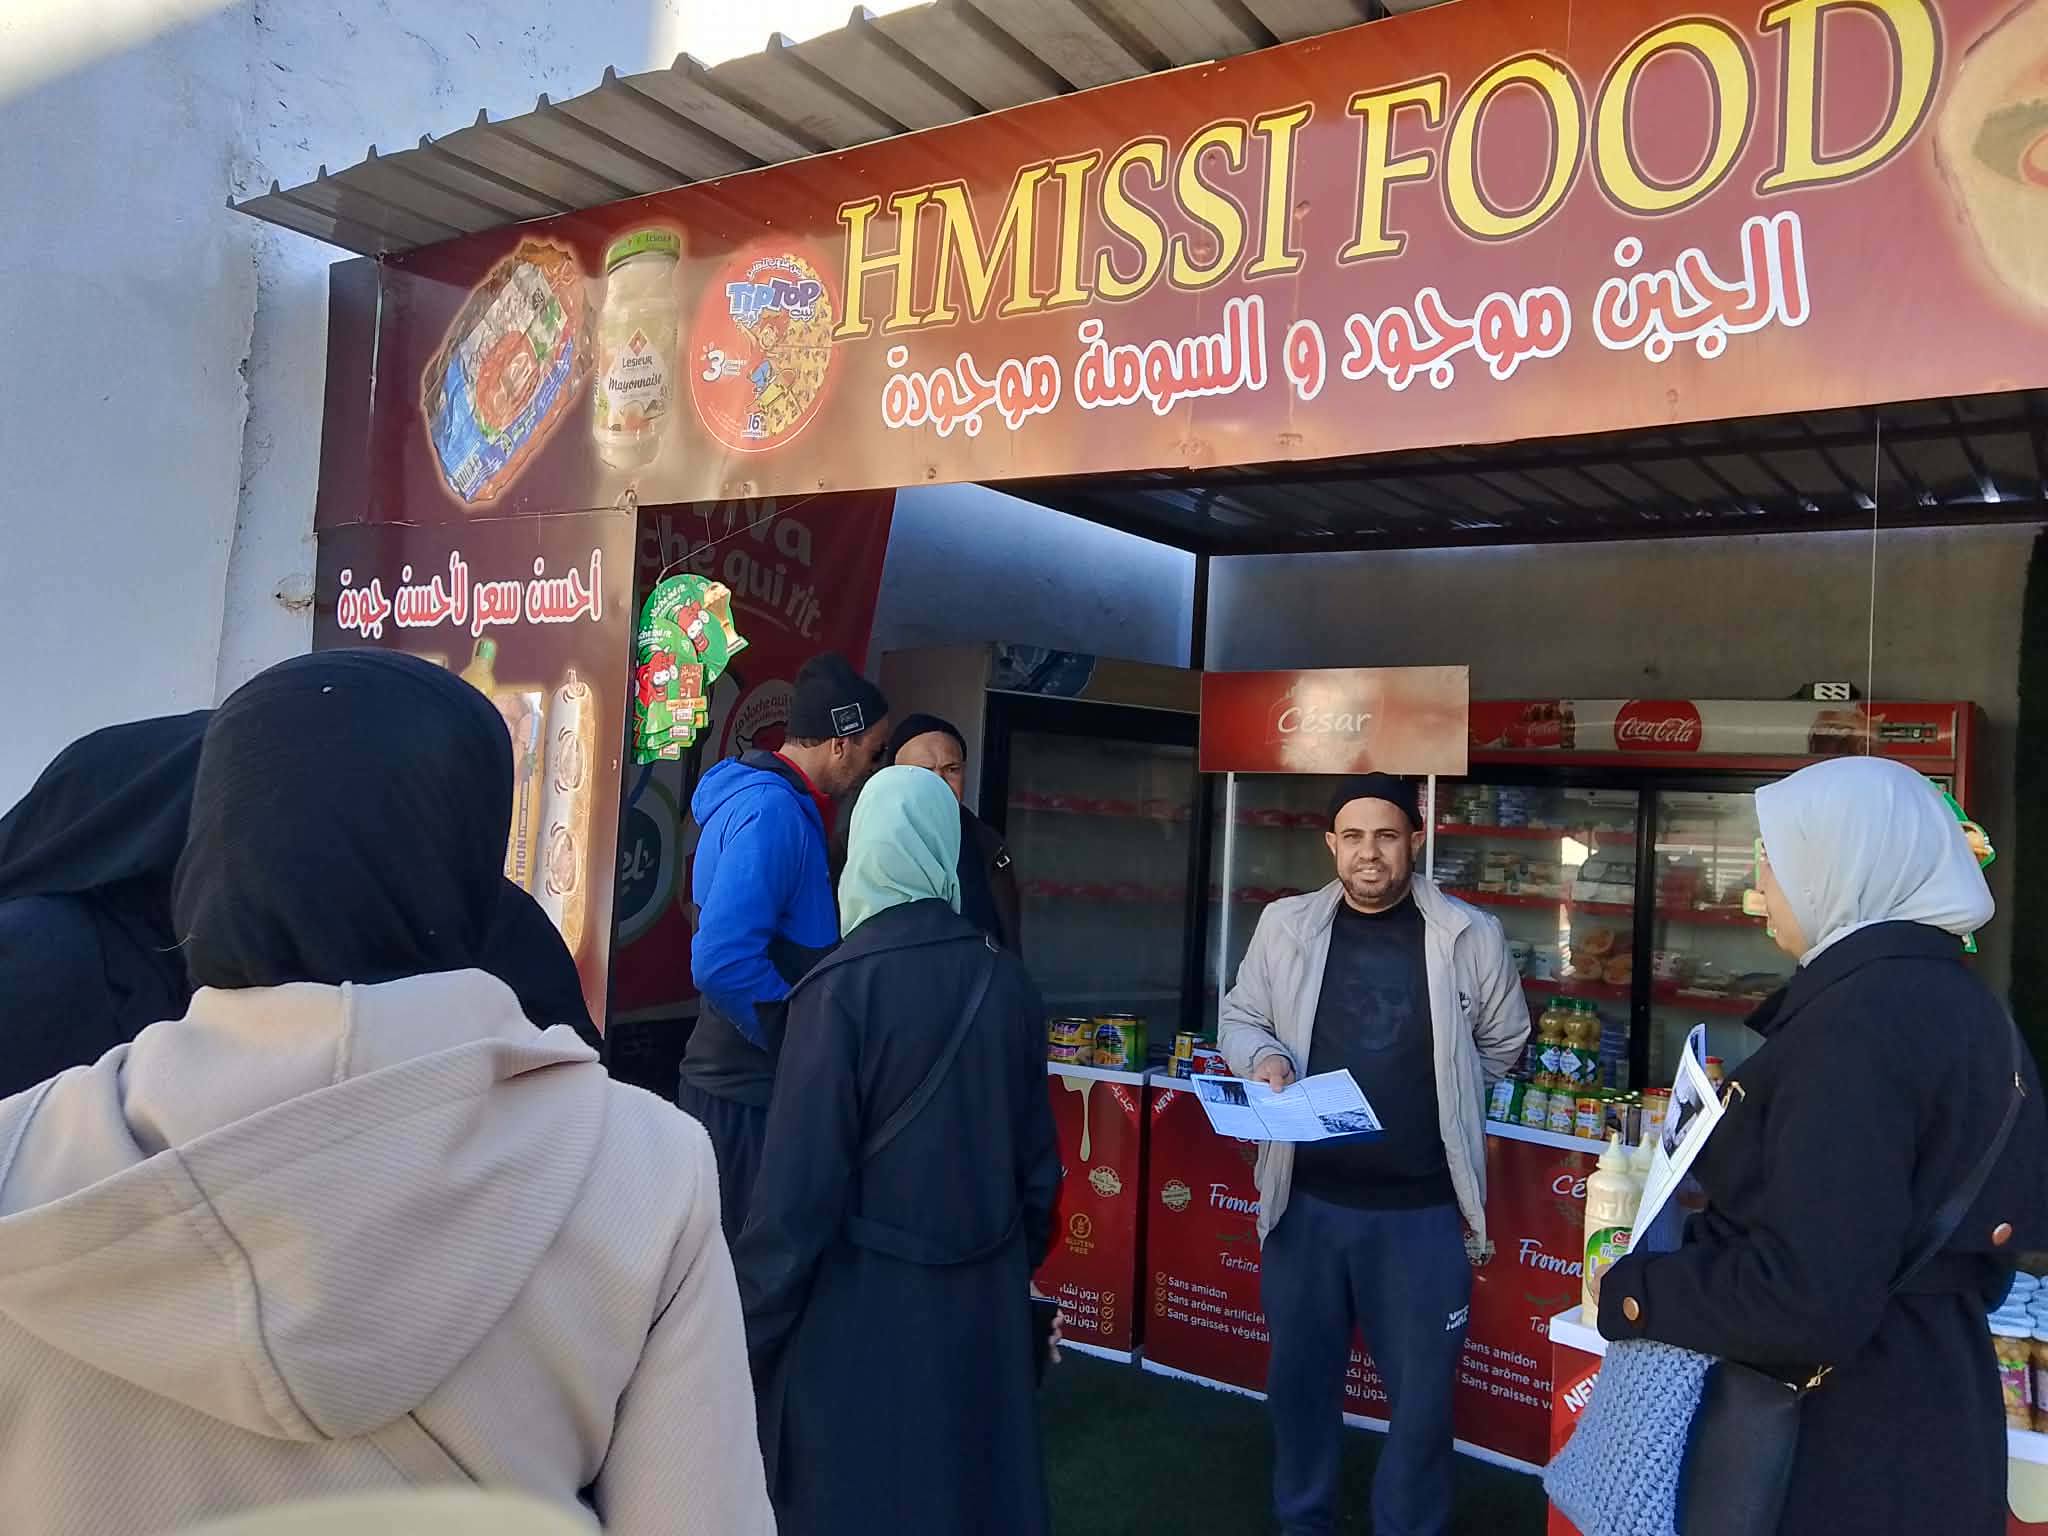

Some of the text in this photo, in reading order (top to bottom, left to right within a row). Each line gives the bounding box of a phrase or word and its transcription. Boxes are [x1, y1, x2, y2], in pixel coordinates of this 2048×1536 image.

[833, 0, 1944, 341] HMISSI FOOD
[882, 211, 1810, 437] الجبن موجود و السومة موجودة
[338, 569, 391, 639] جودة
[471, 581, 520, 637] سعر
[1277, 706, 1372, 734] César
[1167, 1292, 1189, 1307] Sans
[1168, 1276, 1228, 1300] Sans amidon
[1167, 1307, 1189, 1322] Sans
[1190, 1315, 1229, 1334] graisses
[1463, 1338, 1538, 1370] Sans amidon
[1463, 1355, 1489, 1374] Sans
[1462, 1373, 1488, 1392] Sans
[1490, 1383, 1539, 1407] graisses
